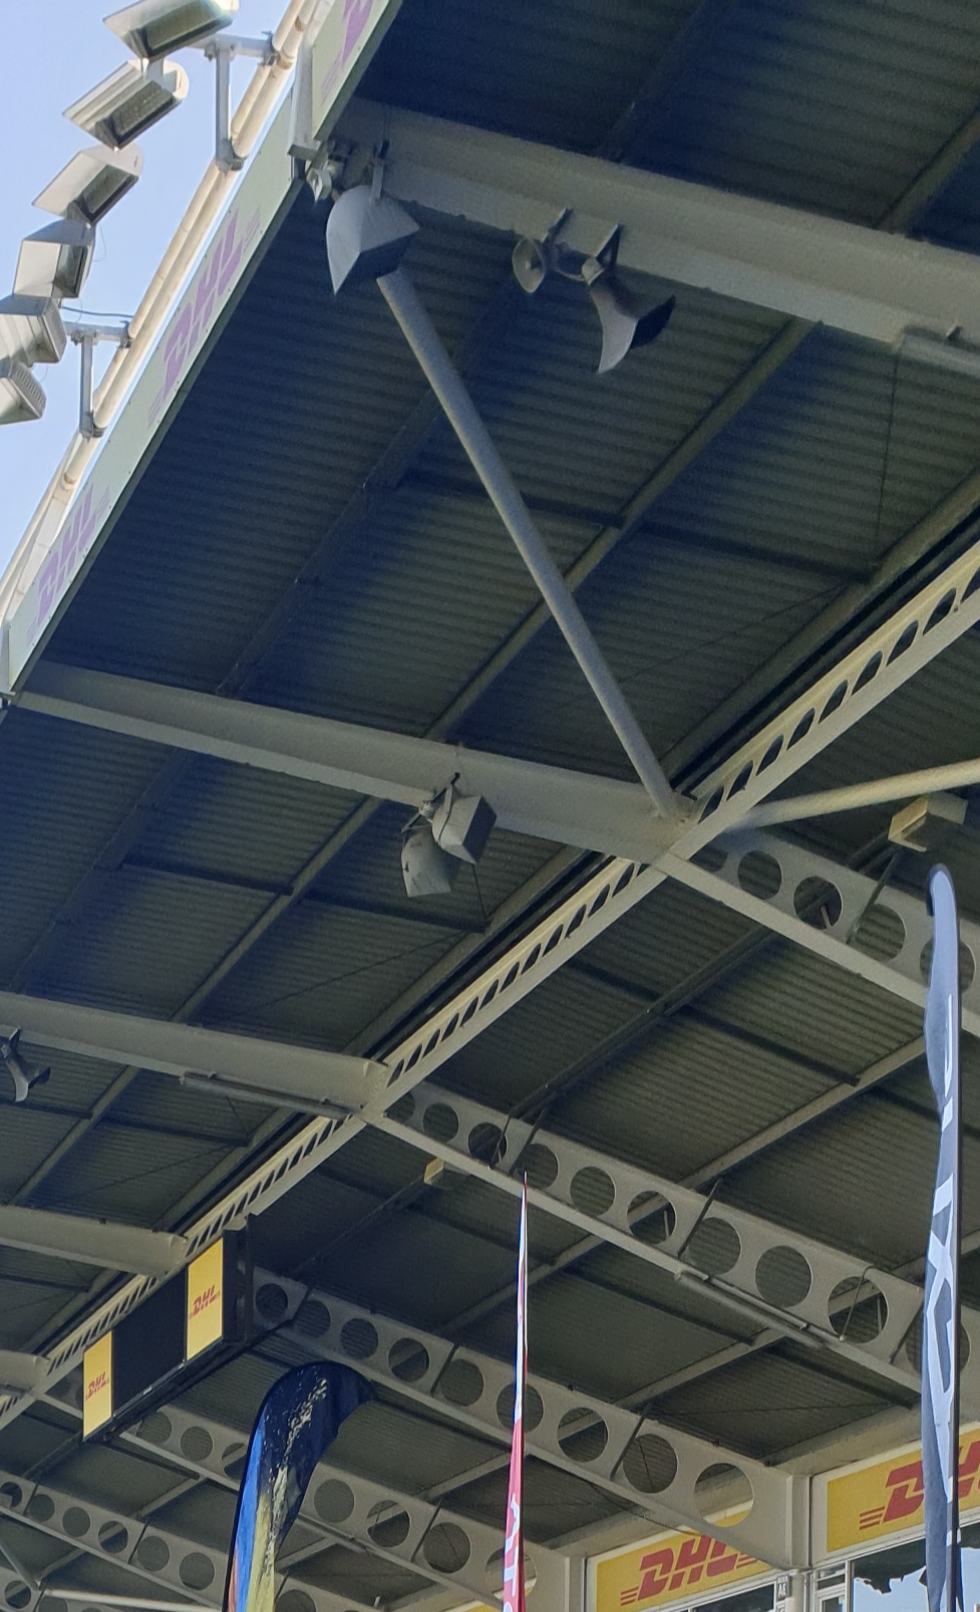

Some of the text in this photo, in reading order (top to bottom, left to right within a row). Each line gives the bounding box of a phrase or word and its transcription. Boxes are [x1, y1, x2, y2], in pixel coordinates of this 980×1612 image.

[164, 208, 244, 401] DHL
[37, 482, 96, 628] DHL
[192, 1284, 218, 1316] DHL
[637, 1535, 738, 1601] DHL
